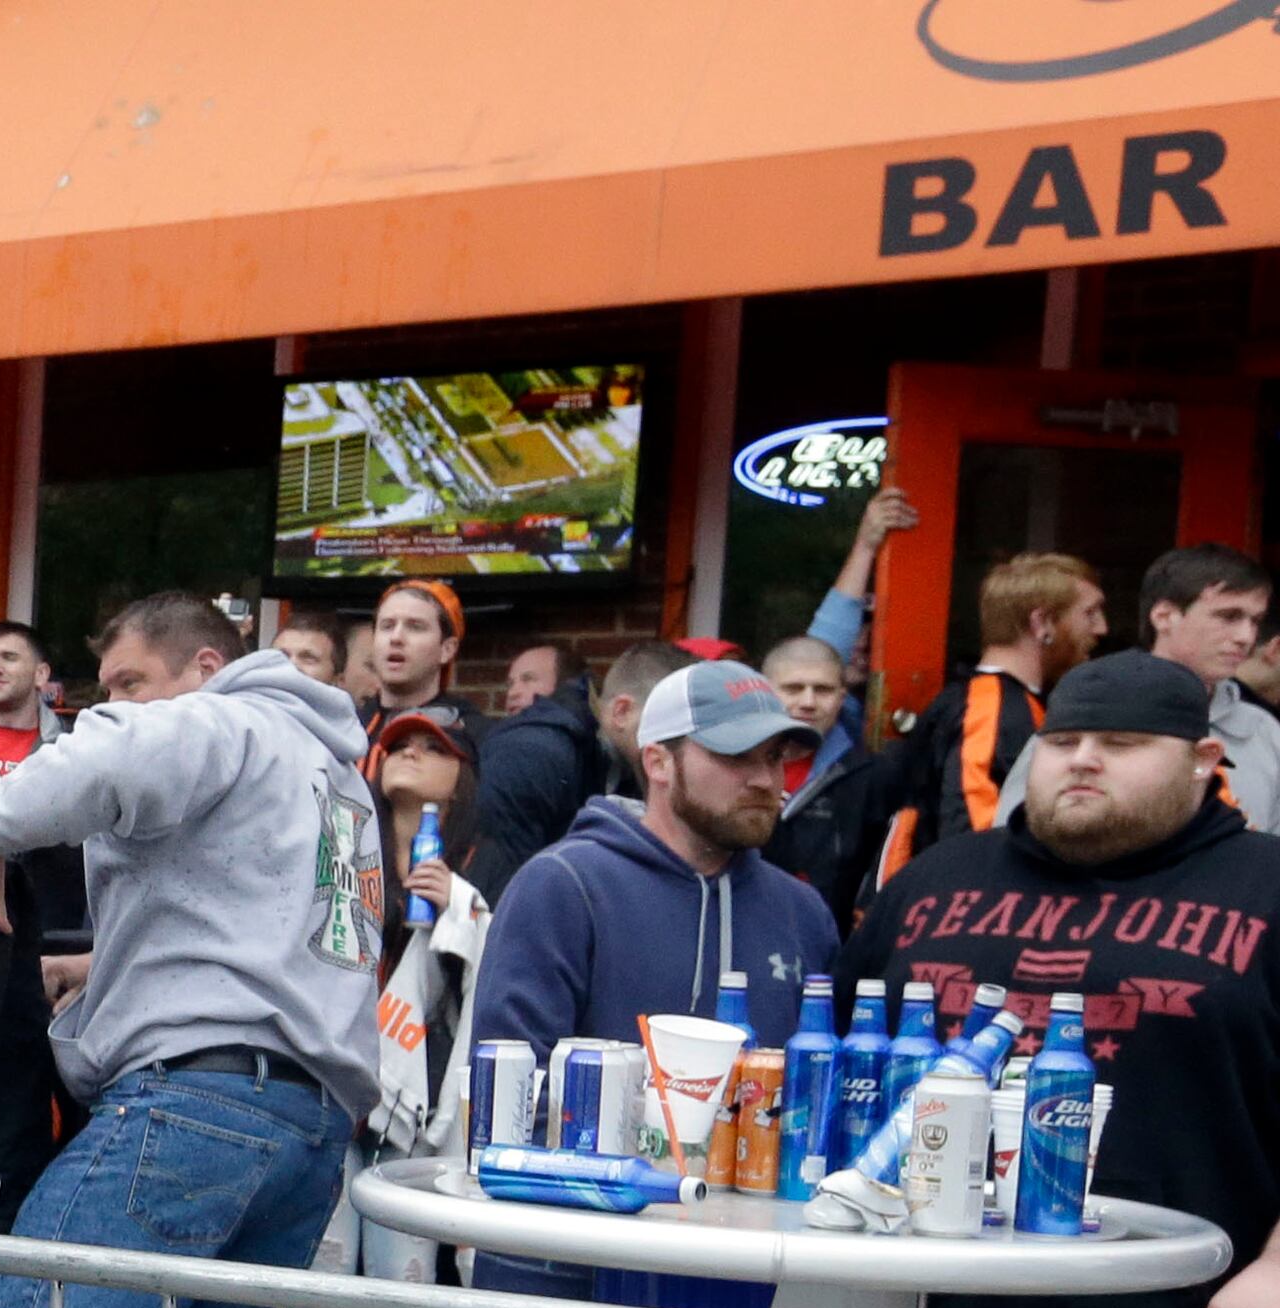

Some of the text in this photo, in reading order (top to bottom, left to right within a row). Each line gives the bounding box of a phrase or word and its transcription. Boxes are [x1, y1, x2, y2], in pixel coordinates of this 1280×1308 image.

[878, 129, 1228, 258] BAR
[844, 1078, 878, 1091] UD
[1054, 1099, 1093, 1114] BU
